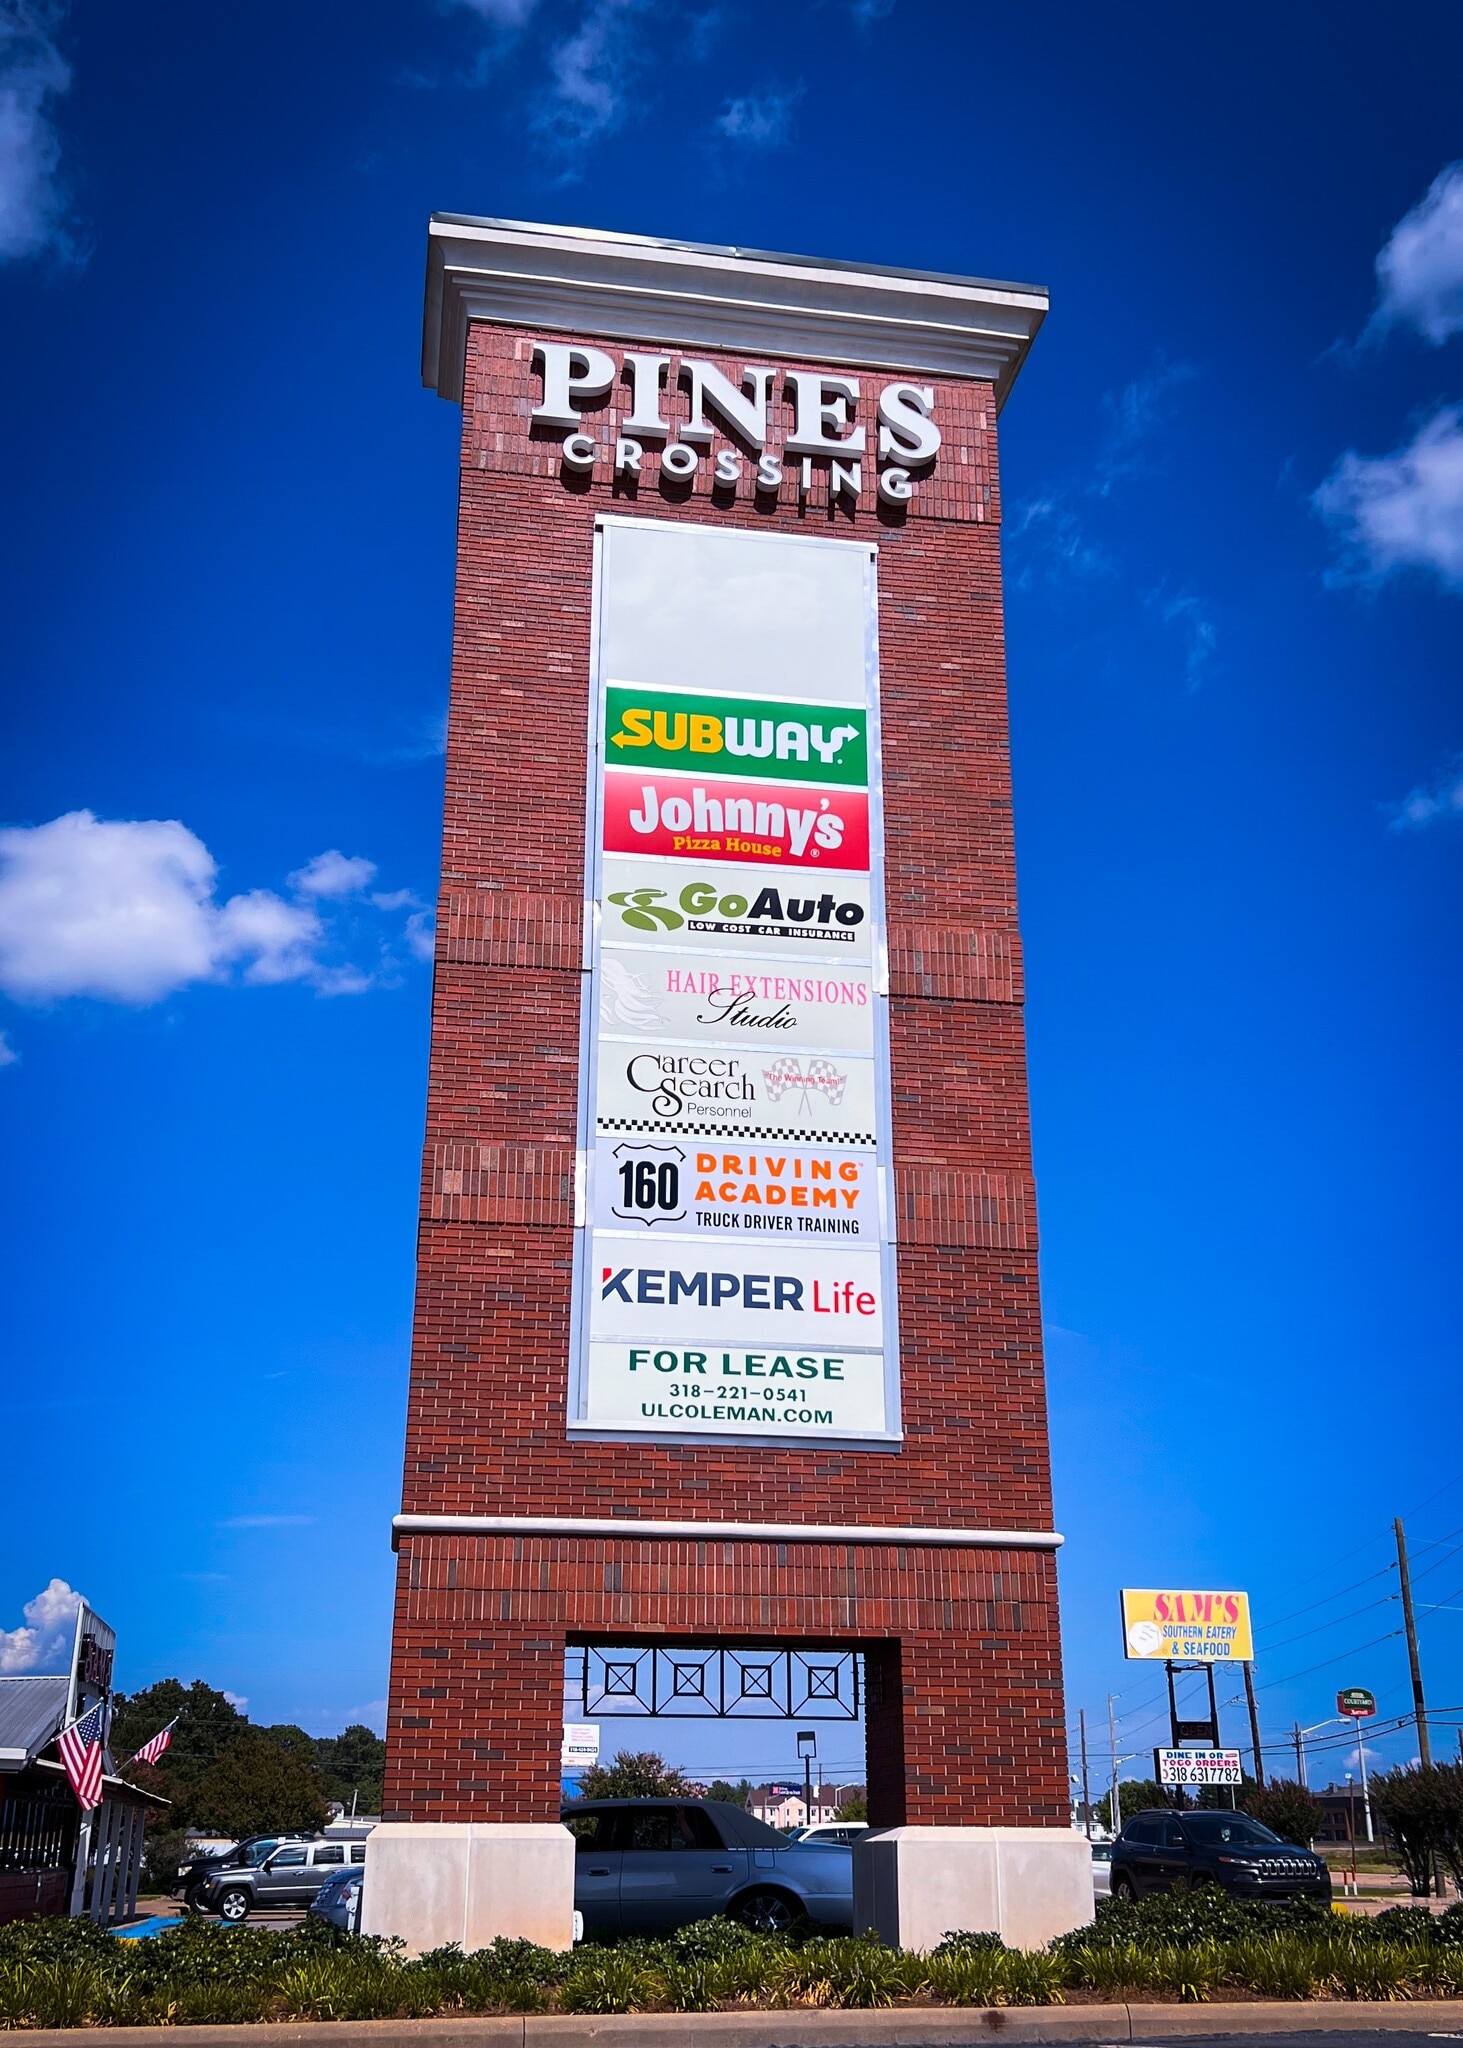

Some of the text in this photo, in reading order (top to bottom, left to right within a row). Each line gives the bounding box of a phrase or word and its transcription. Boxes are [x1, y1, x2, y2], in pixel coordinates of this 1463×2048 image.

[531, 343, 941, 466] PINES
[563, 433, 912, 506] CROSSING
[611, 709, 860, 763] SUBWAY
[629, 786, 844, 856] Johnny's
[673, 836, 782, 857] Pizza House
[679, 883, 864, 925] GoAuto
[690, 922, 853, 940] LOW COST CAR INSURANCE
[667, 970, 867, 1005] HAIR EXTENSIONS
[697, 988, 797, 1029] Studio
[627, 1055, 739, 1092] Career
[652, 1073, 755, 1116] Search
[688, 1103, 751, 1117] Personnel
[697, 1153, 858, 1181] DRIVING
[619, 1161, 678, 1210] 160
[695, 1181, 860, 1209] ACADEMY
[696, 1212, 859, 1234] TRUCK DRIVER TRAINING
[602, 1268, 876, 1315] KEMPER Life
[629, 1349, 844, 1381] FOR LEASE
[670, 1384, 806, 1402] 318-221-0541
[641, 1403, 833, 1424] ULCOLEMAN.COM
[1154, 1593, 1239, 1623] SAM'S
[1163, 1625, 1237, 1639] SOUTHERN EATERY
[1172, 1641, 1230, 1655] & SEAFOOD
[1169, 1767, 1187, 1781] 318
